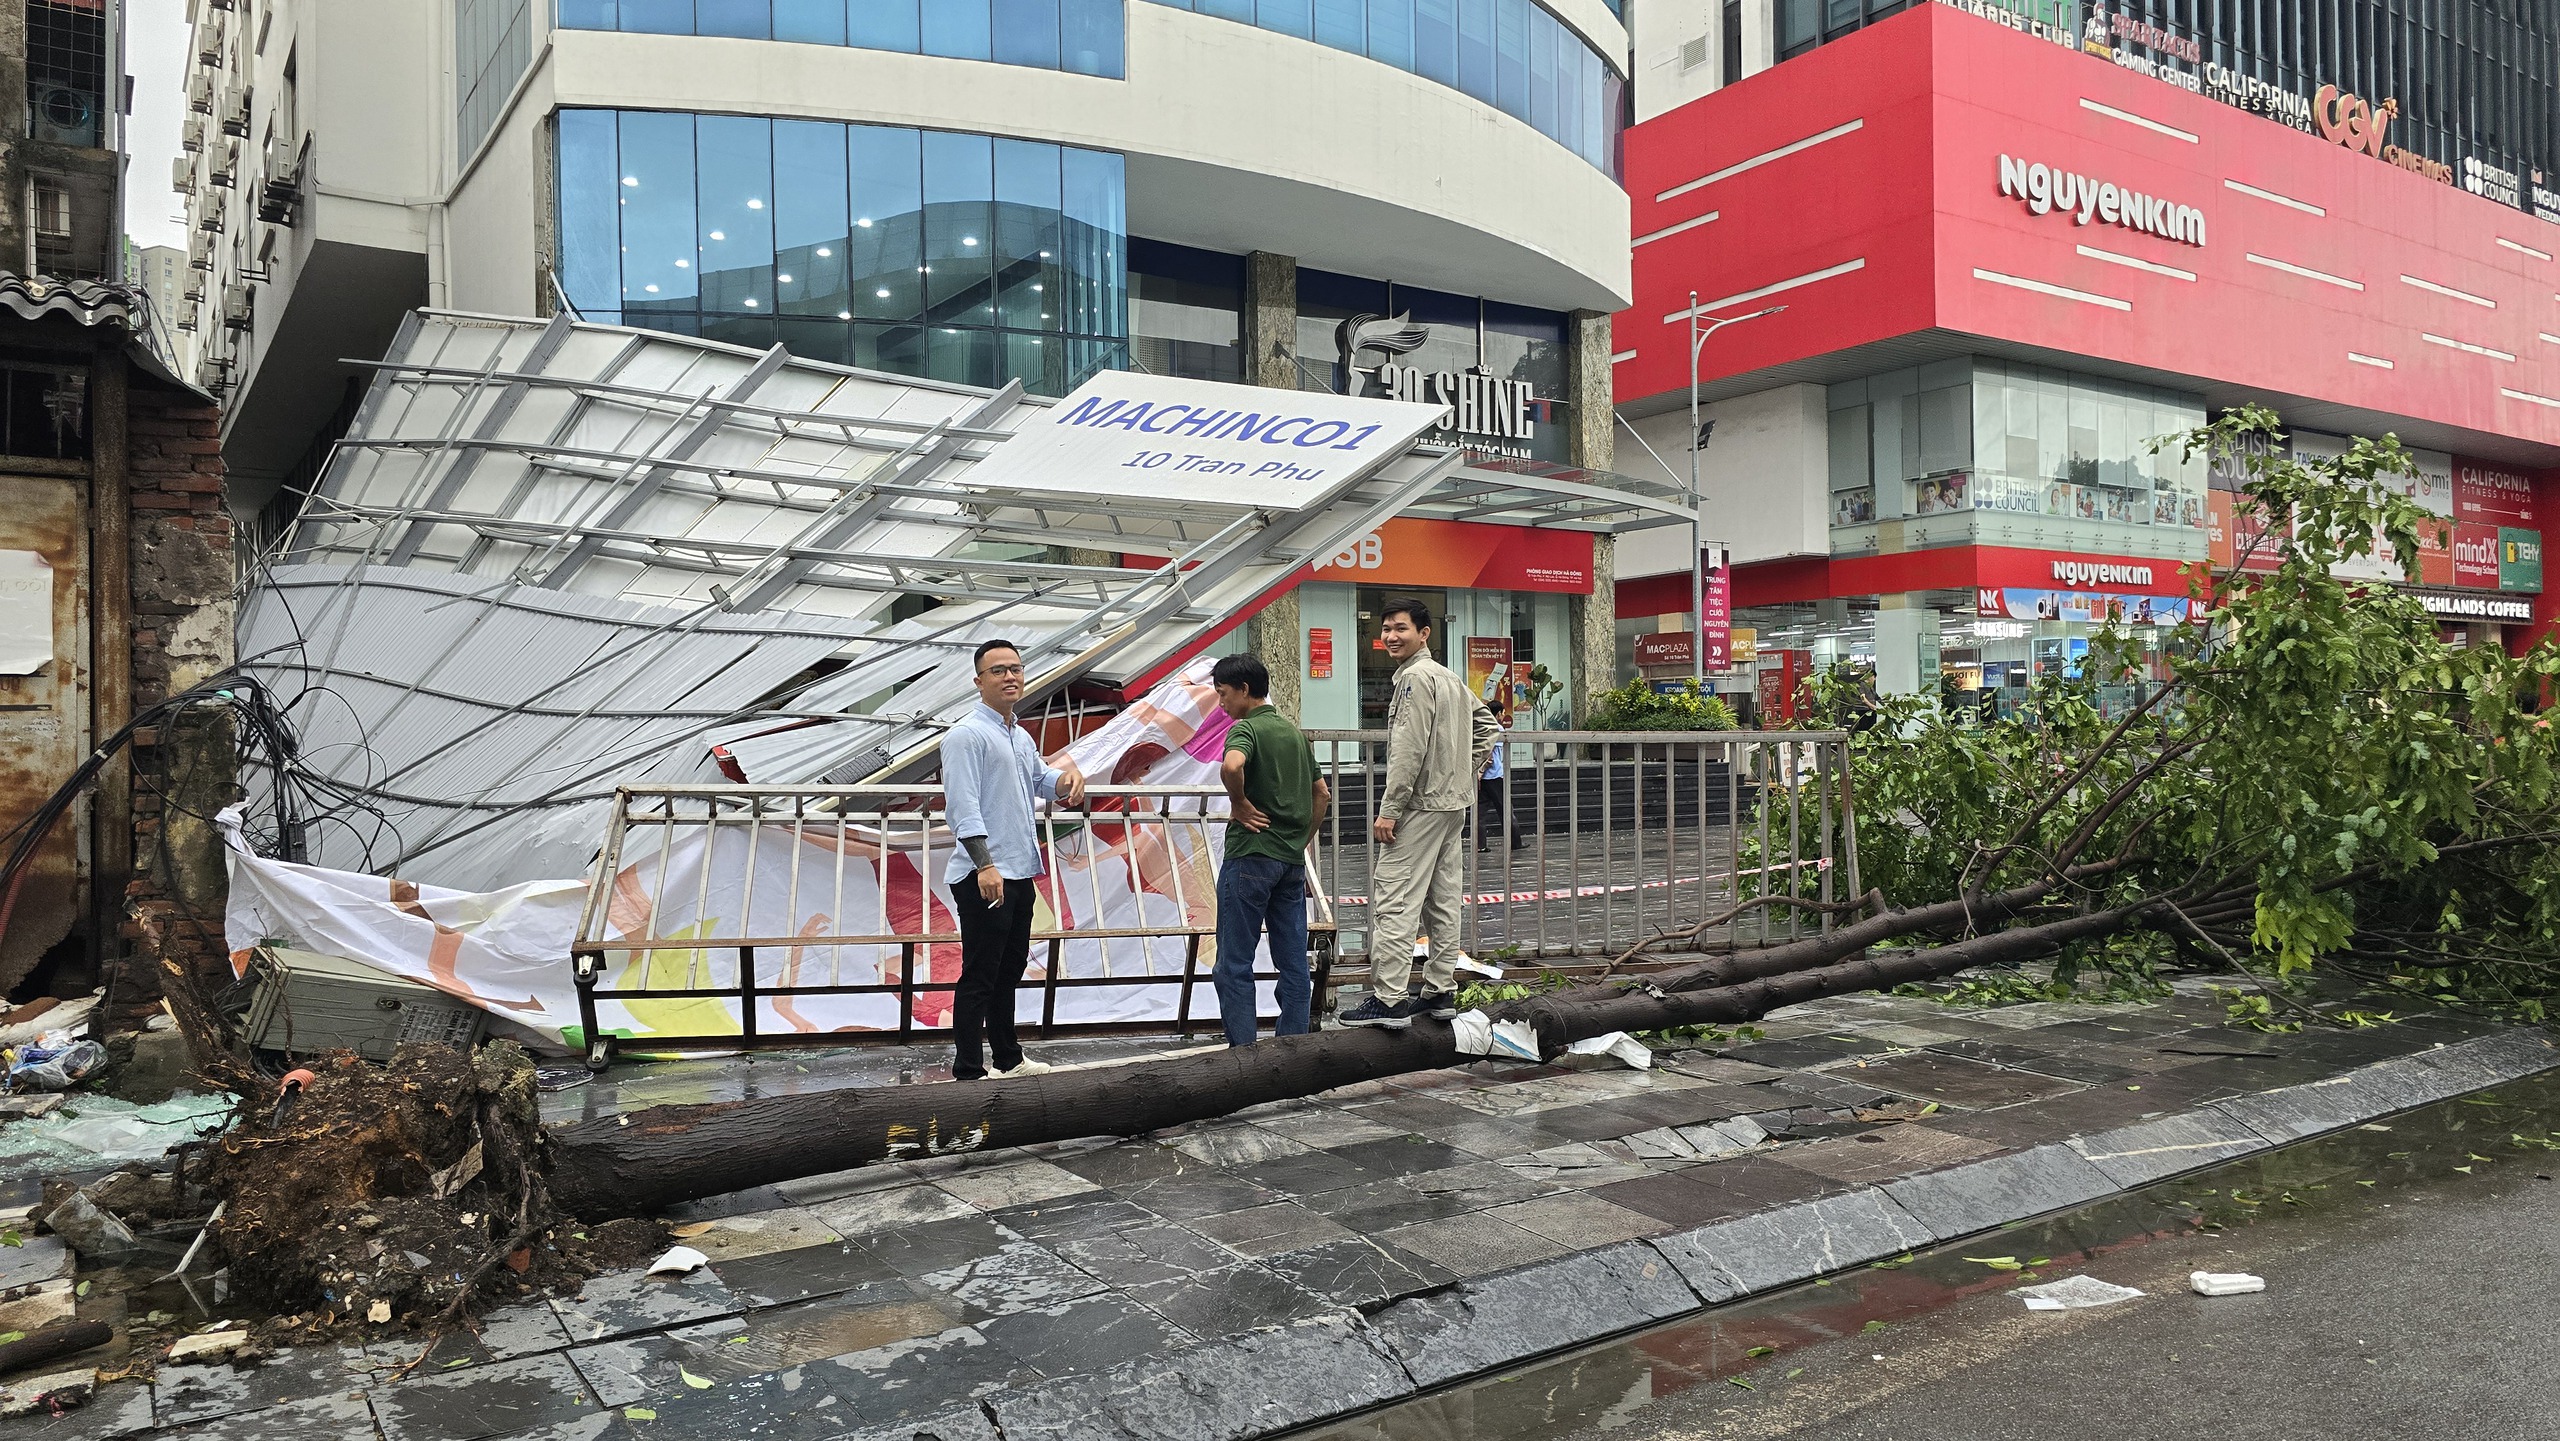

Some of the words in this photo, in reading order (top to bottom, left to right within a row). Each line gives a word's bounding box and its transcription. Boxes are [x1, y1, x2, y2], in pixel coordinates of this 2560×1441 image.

[2031, 20, 2075, 49] CLUB
[2112, 47, 2157, 78] GAMING
[2159, 65, 2201, 94] CENTER
[2206, 61, 2312, 121] CALIFORNIA
[2206, 85, 2274, 112] FITNESS
[2278, 111, 2312, 134] YOGA
[2314, 84, 2388, 158] CGV
[2384, 144, 2453, 186] CINEMAS
[2483, 163, 2518, 190] BRITISH
[2484, 181, 2520, 208] COUNCIL
[1382, 363, 1425, 402] 30
[1436, 370, 1534, 440] SHINE
[1056, 396, 1383, 450] MACHINCO1
[1121, 451, 1172, 469] 10
[1174, 453, 1245, 475] Tran
[1248, 461, 1325, 481] Phu
[1995, 480, 2037, 496] BRITISH
[2461, 467, 2531, 494] CALIFORNIA
[2462, 485, 2498, 499] FITNESS
[2510, 493, 2531, 503] YOGA
[1995, 496, 2039, 512] COUNCIL
[1327, 533, 1382, 568] SB
[2455, 537, 2498, 564] mindX
[1705, 576, 1726, 584] TRUNG
[2456, 562, 2482, 576] Technology
[2482, 565, 2498, 576] School
[2487, 602, 2531, 619] COFFEE
[1973, 621, 2024, 638] SAMSUNG
[1646, 643, 1689, 654] MACPLAZA
[1732, 641, 1756, 650] ACPLA
